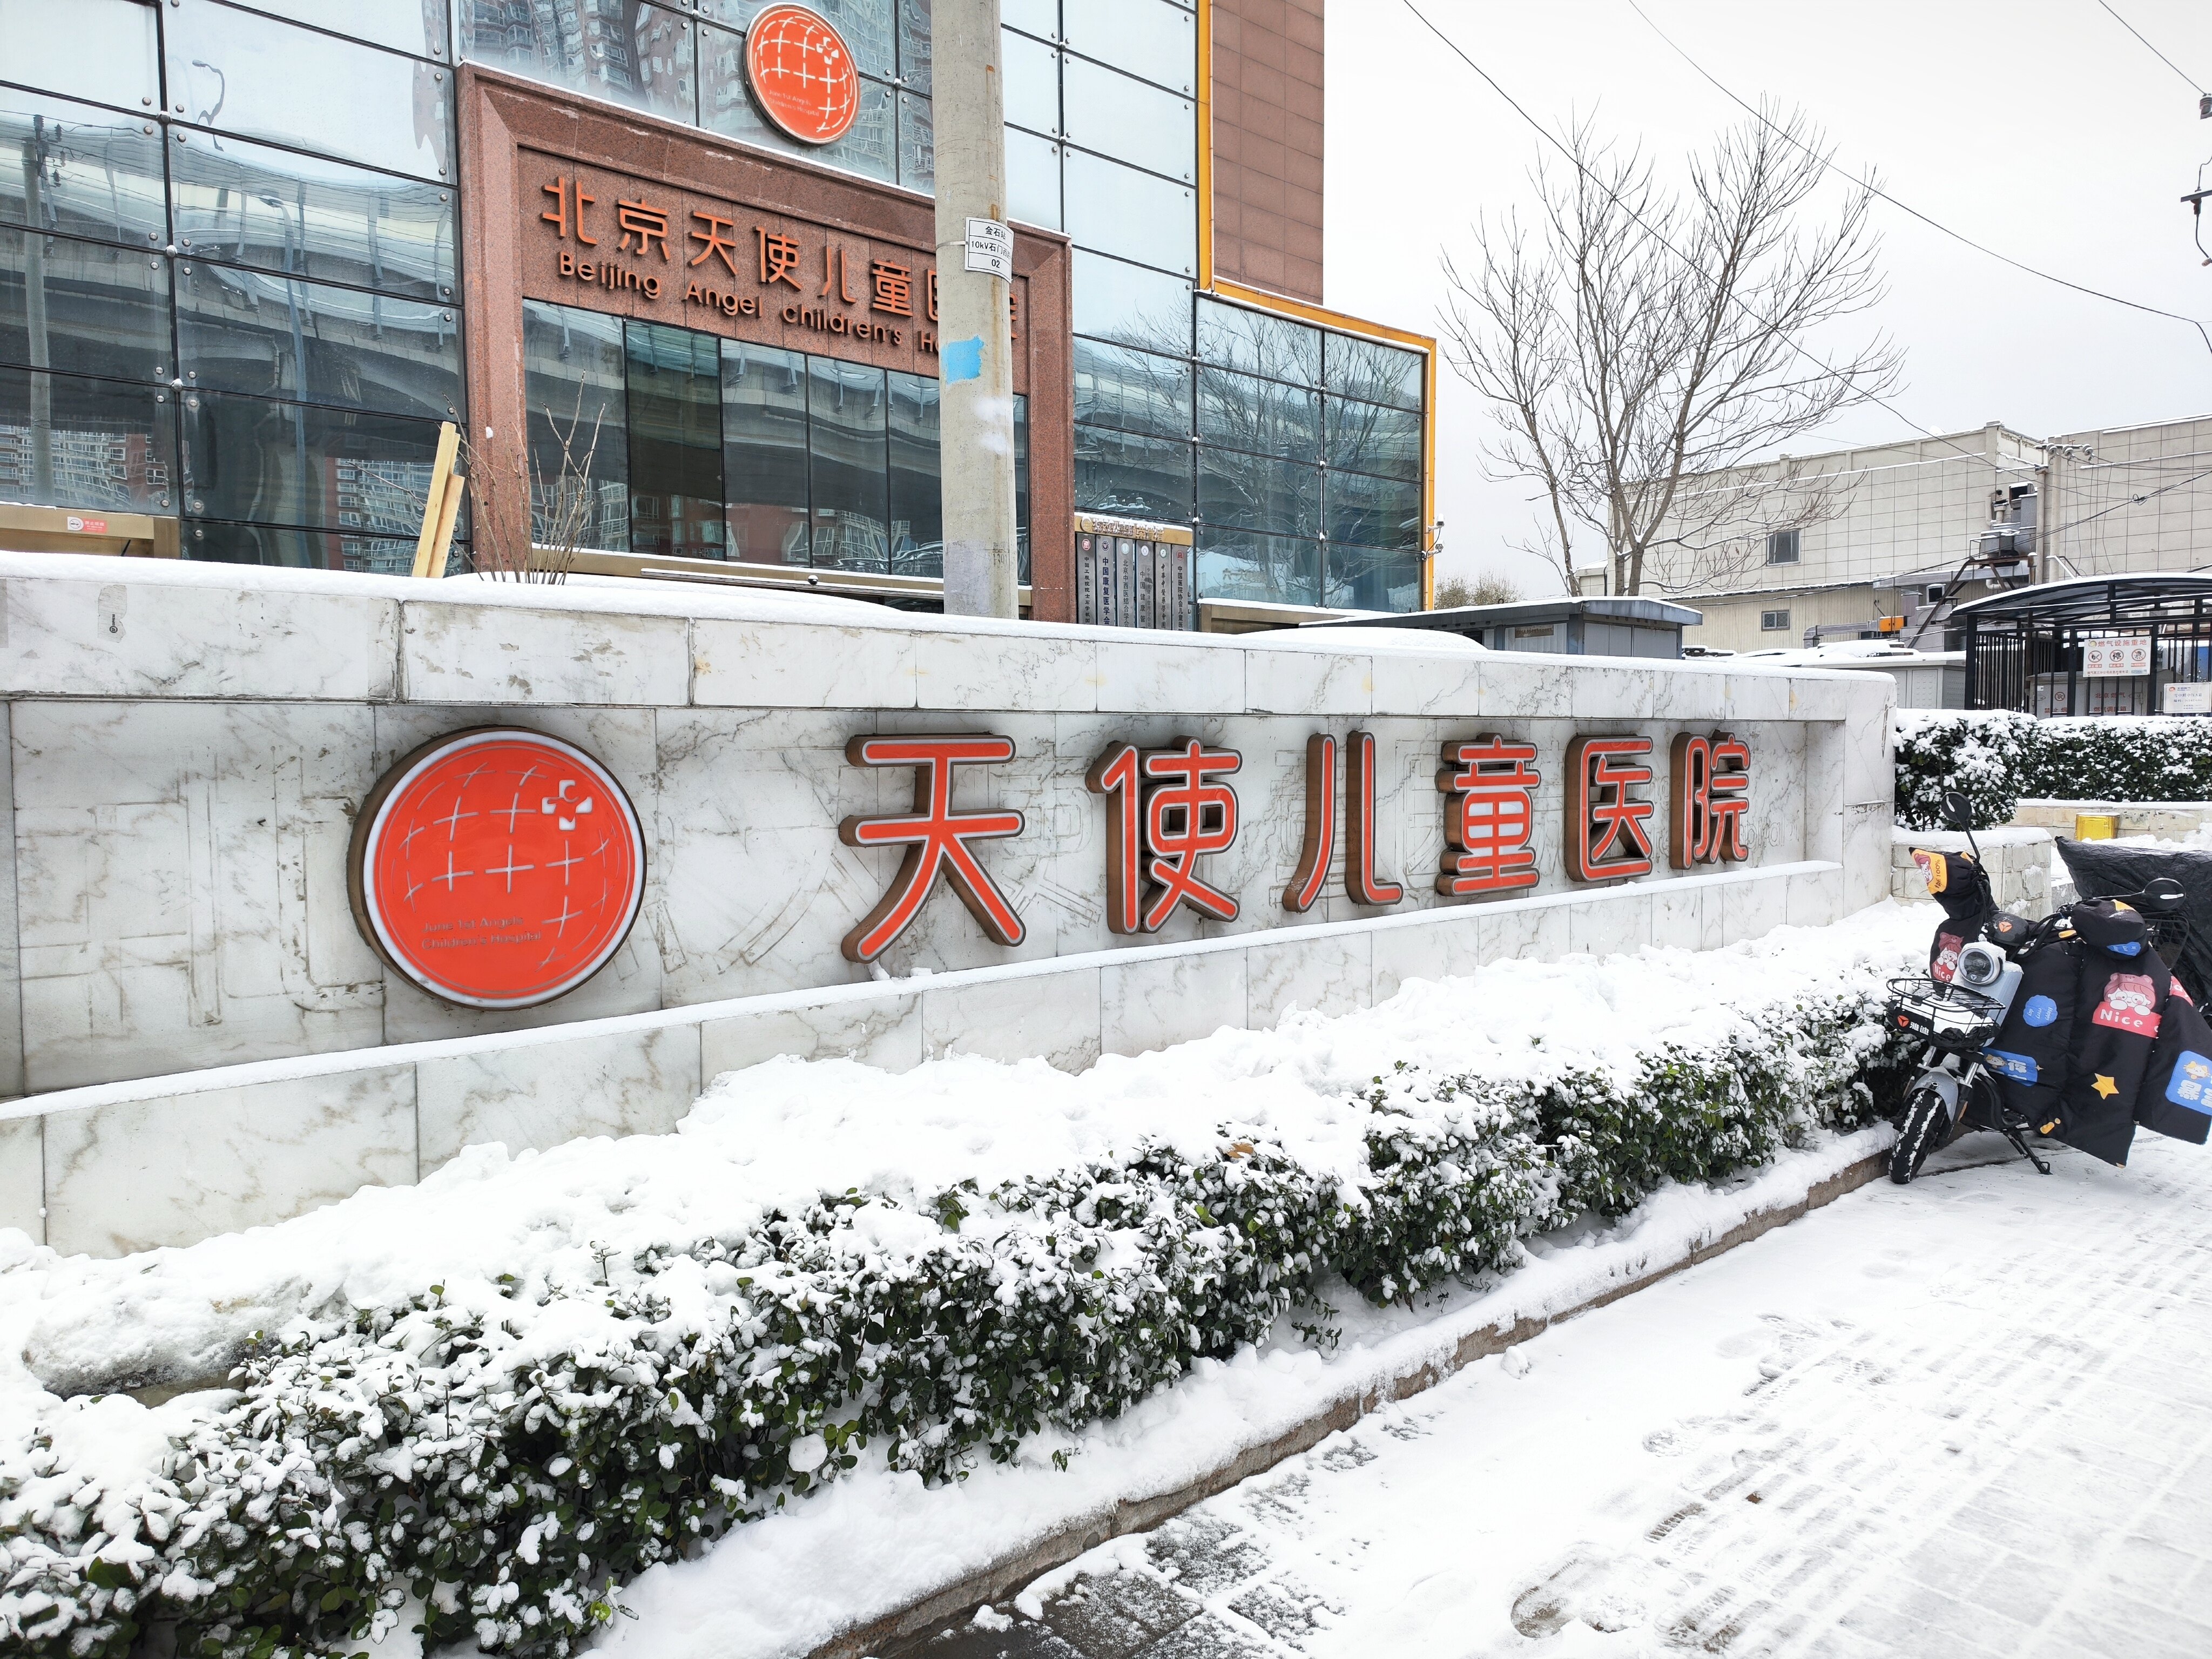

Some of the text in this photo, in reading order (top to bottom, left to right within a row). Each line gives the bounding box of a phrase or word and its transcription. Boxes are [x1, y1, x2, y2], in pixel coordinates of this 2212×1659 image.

[986, 226, 1006, 239] 金石站
[540, 176, 1017, 339] 北京天使儿童
[991, 259, 1000, 268] 02
[559, 251, 661, 299] Beijing
[683, 280, 763, 318] Angel
[1102, 557, 1110, 625] 中国康复医学会
[2098, 639, 2147, 647] 燃气设施重地
[840, 732, 1751, 964] 天使儿童医院
[422, 915, 523, 933] June 1st Angels
[422, 930, 542, 950] Children's Hospital
[1934, 963, 1952, 981] Nice
[2100, 1008, 2143, 1028] Nice
[1909, 1021, 1929, 1036] 雅迪
